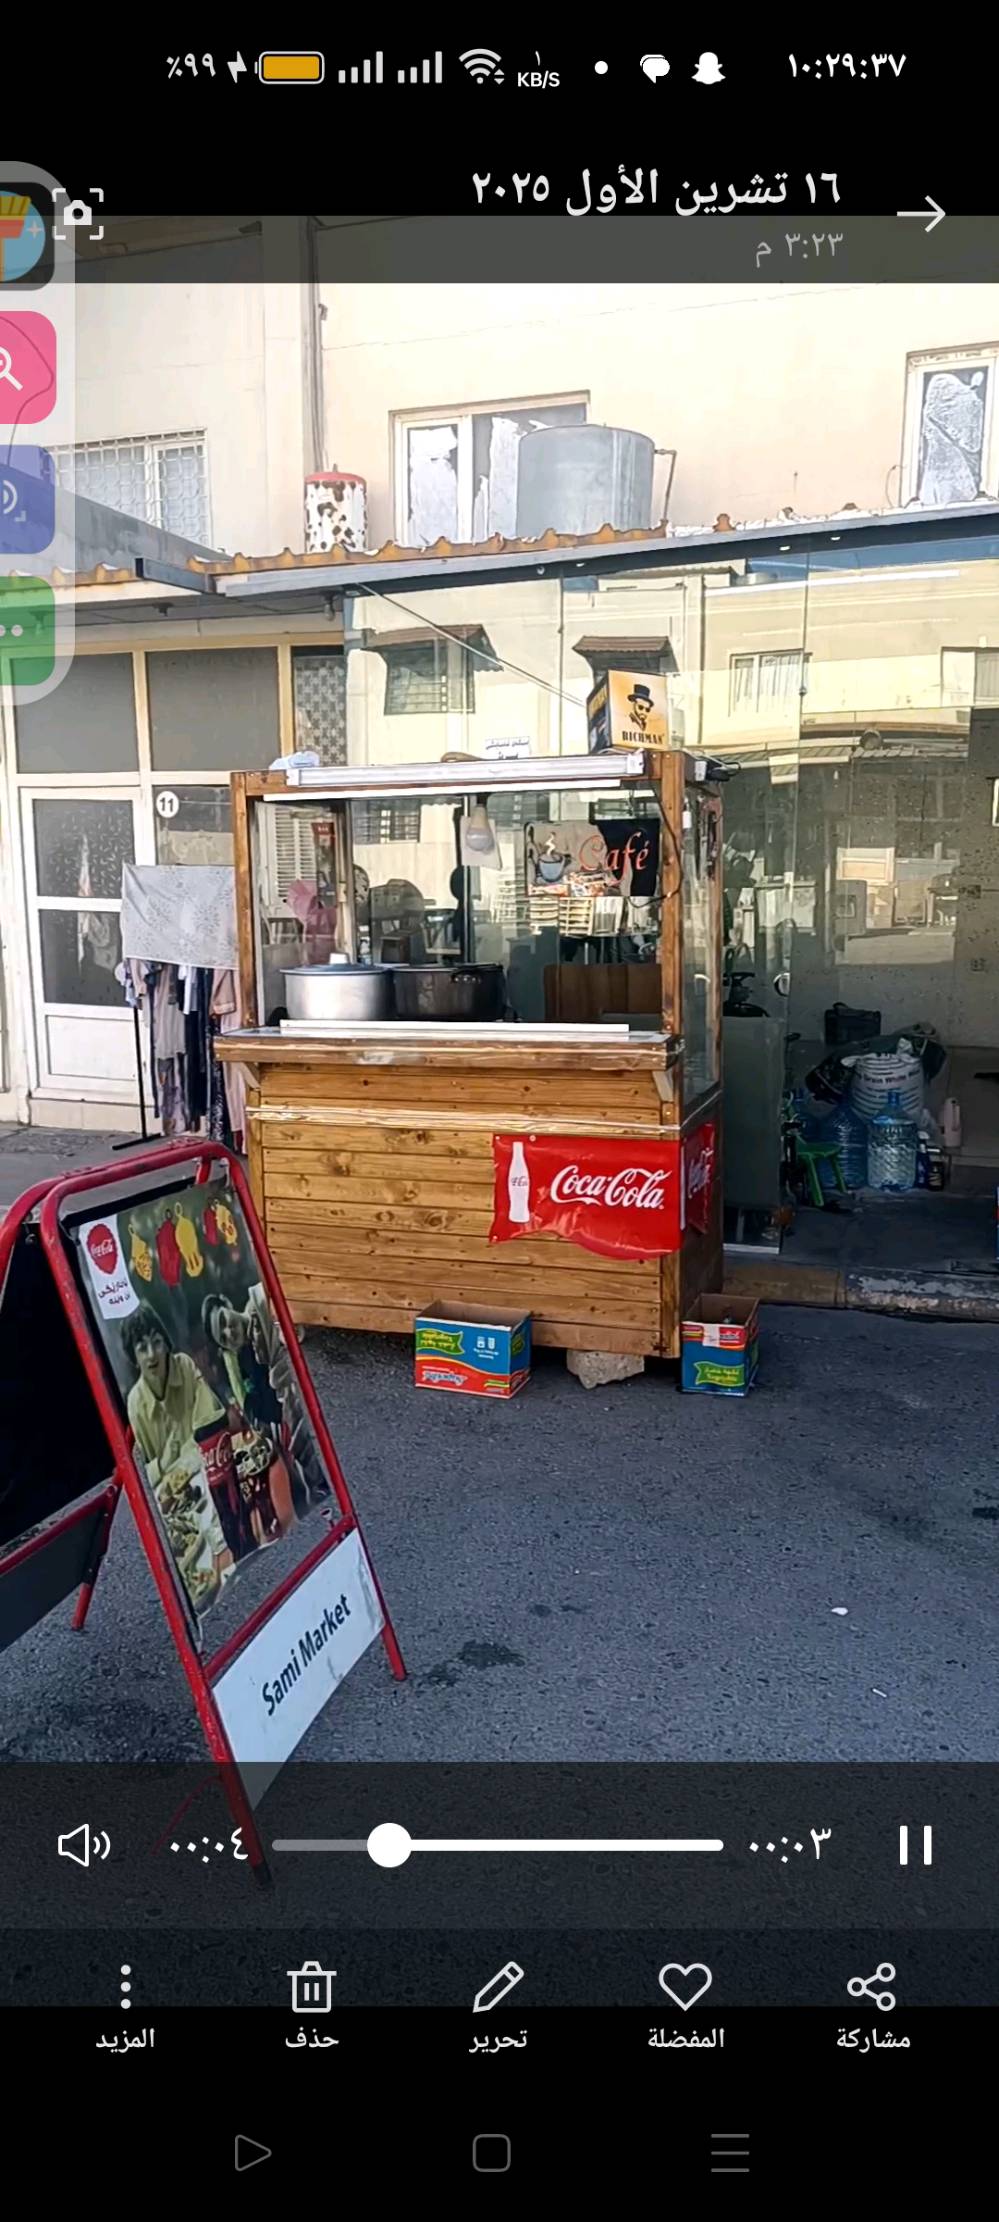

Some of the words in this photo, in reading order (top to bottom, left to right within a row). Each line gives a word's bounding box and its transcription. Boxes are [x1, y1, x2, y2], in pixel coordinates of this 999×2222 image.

[159, 797, 174, 812] 11
[578, 827, 650, 887] Café
[551, 1164, 673, 1210] Coca-Cola
[262, 1648, 301, 1716] Sami
[298, 1593, 351, 1668] Market
